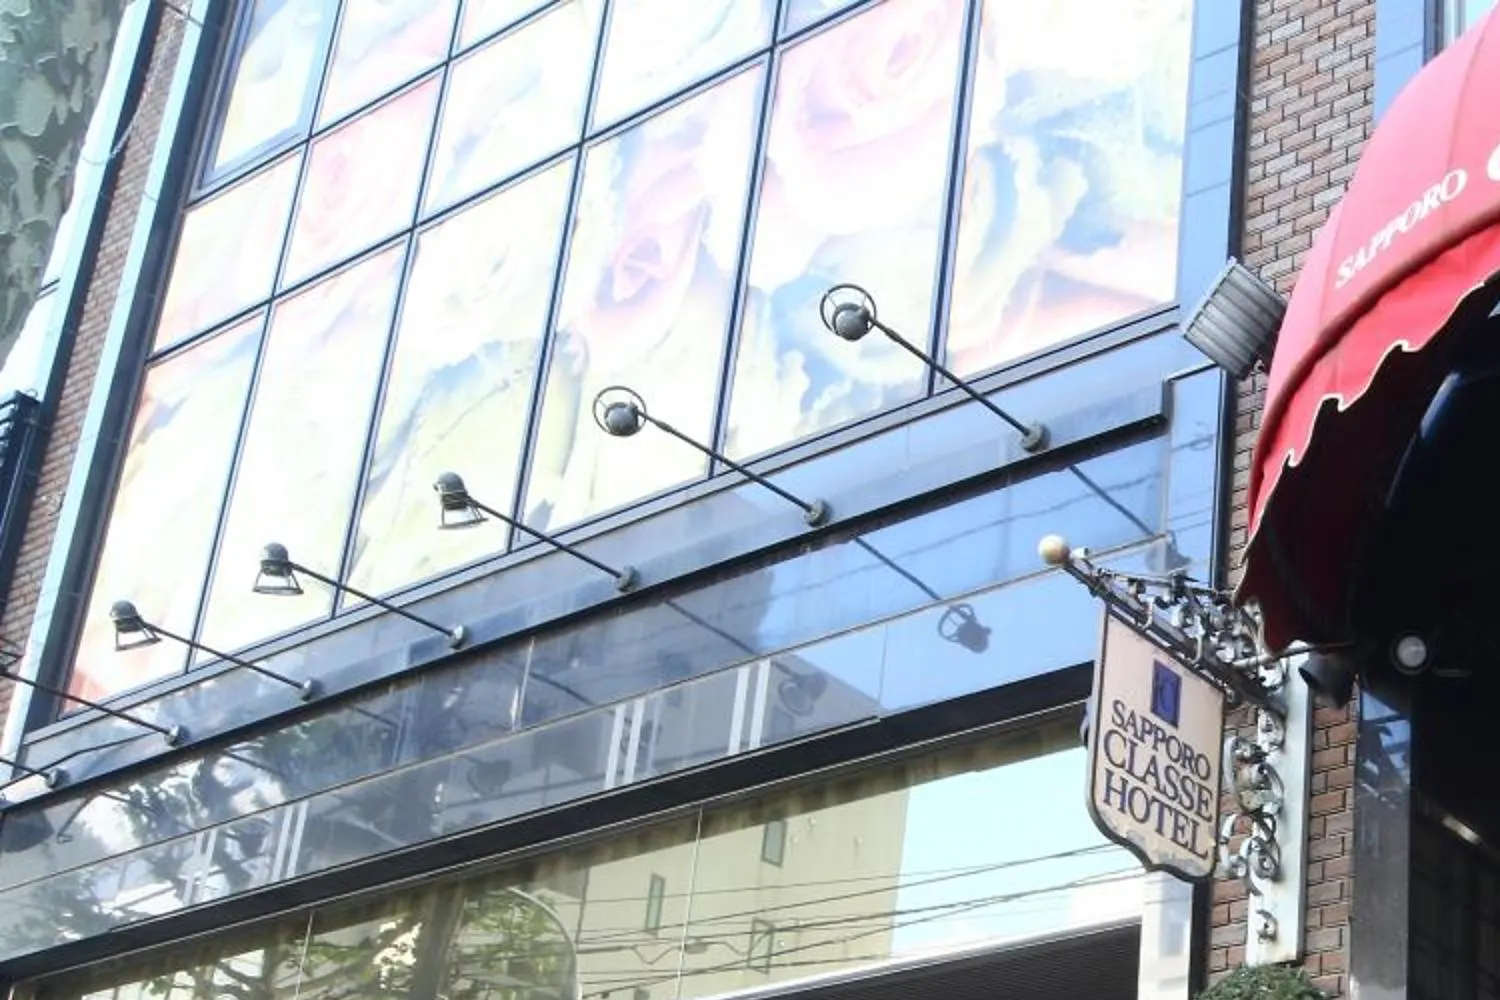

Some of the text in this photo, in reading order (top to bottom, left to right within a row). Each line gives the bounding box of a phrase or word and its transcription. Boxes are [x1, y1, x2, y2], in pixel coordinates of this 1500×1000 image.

[1334, 168, 1468, 289] SAPPORO
[1103, 729, 1213, 823] CLASSE
[1111, 699, 1211, 781] SAPPORO
[1103, 767, 1209, 860] HOTEL
